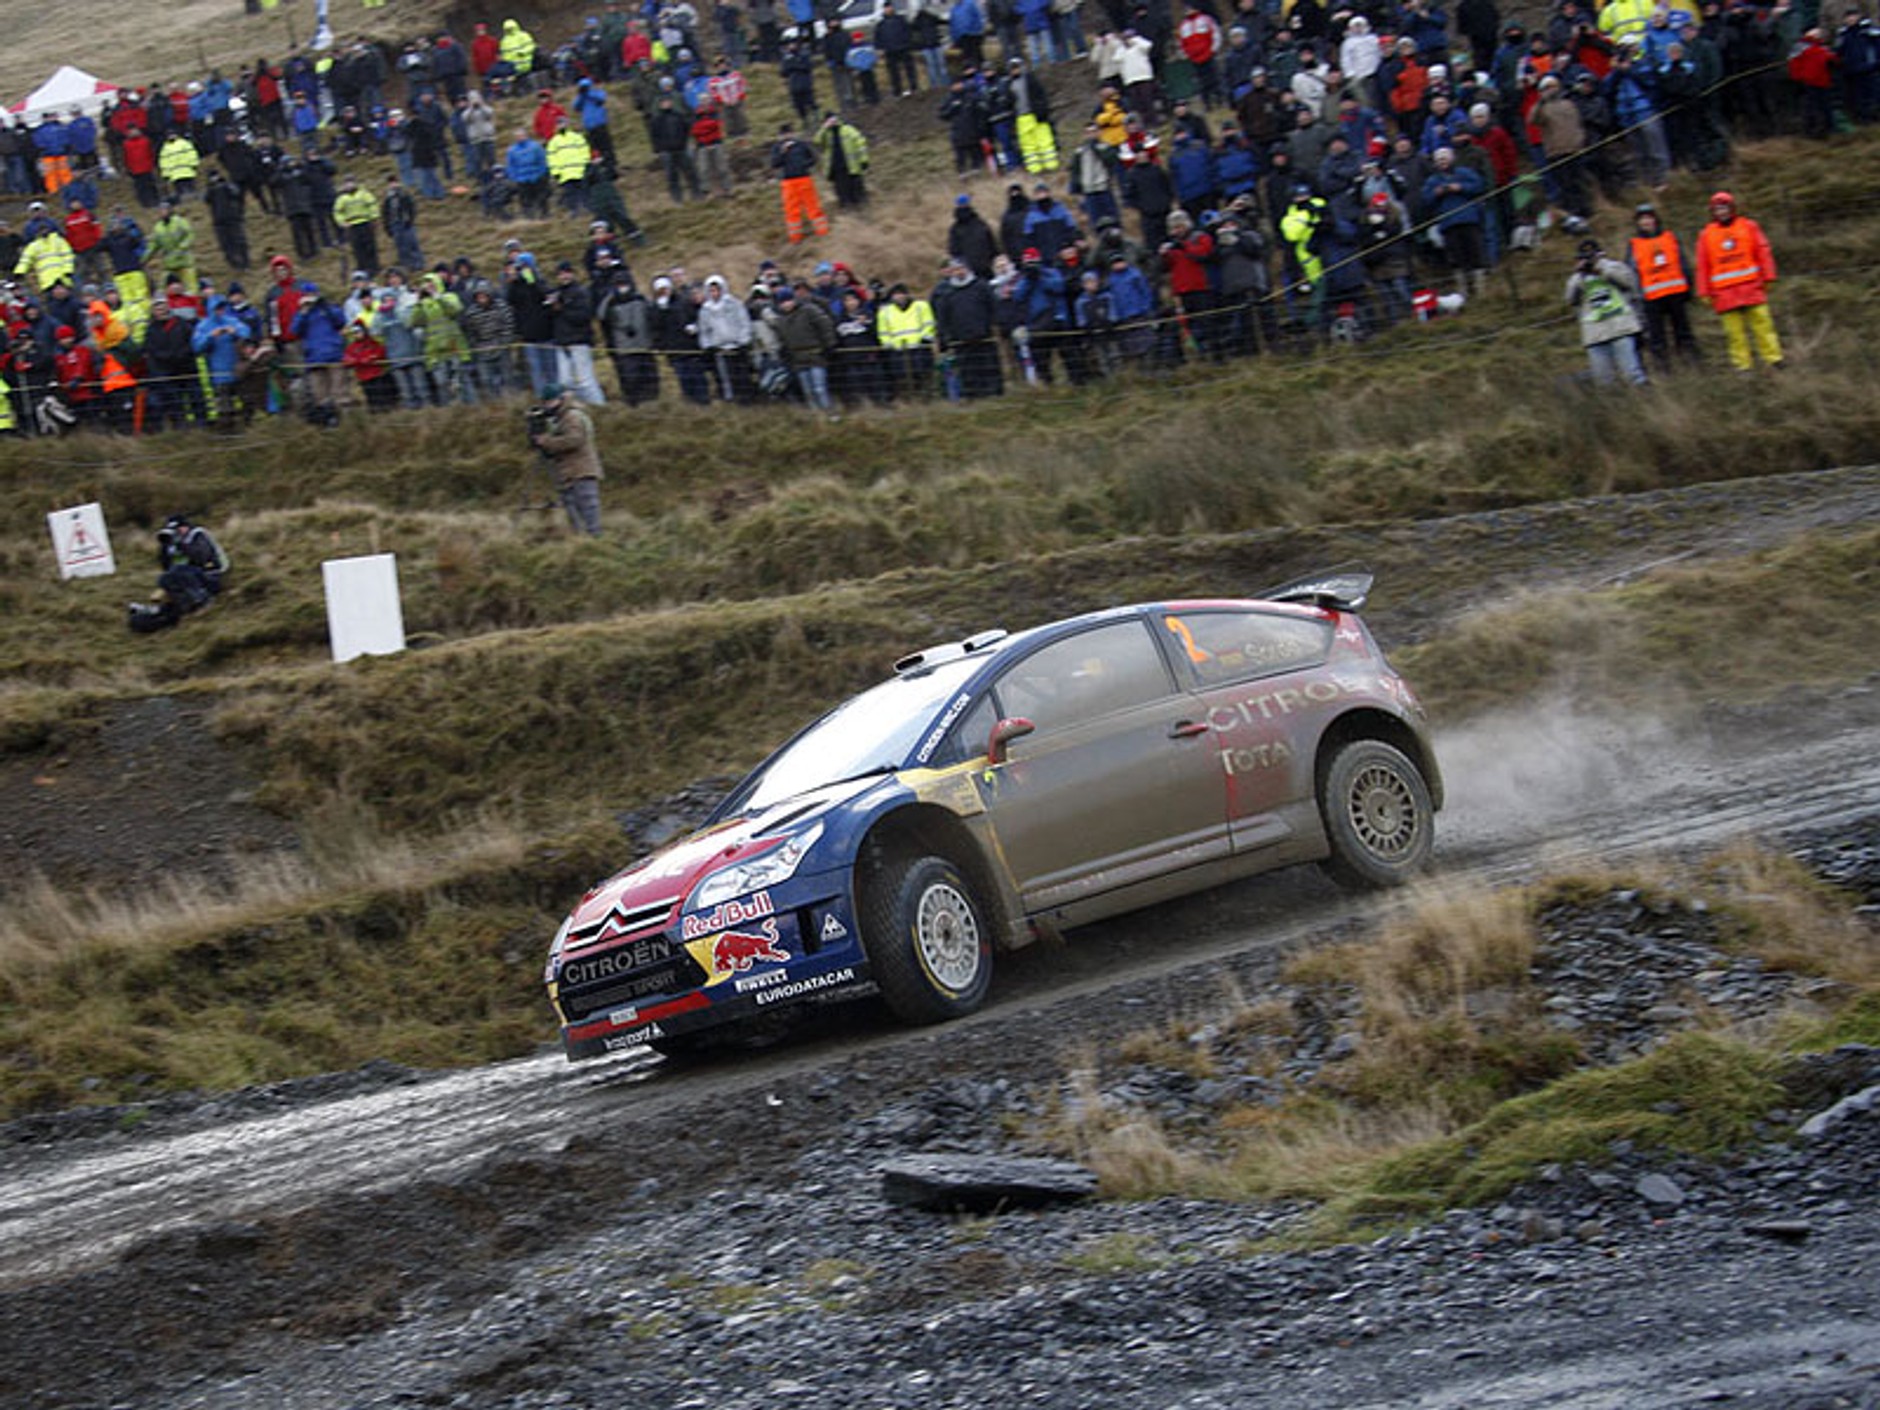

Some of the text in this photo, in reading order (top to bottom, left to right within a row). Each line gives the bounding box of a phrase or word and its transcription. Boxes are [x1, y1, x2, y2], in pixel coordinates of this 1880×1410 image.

[1164, 615, 1208, 664] 2
[682, 890, 775, 939] Red Bull
[565, 940, 670, 983] CITROËN
[755, 968, 855, 1006] EURODATACAR
